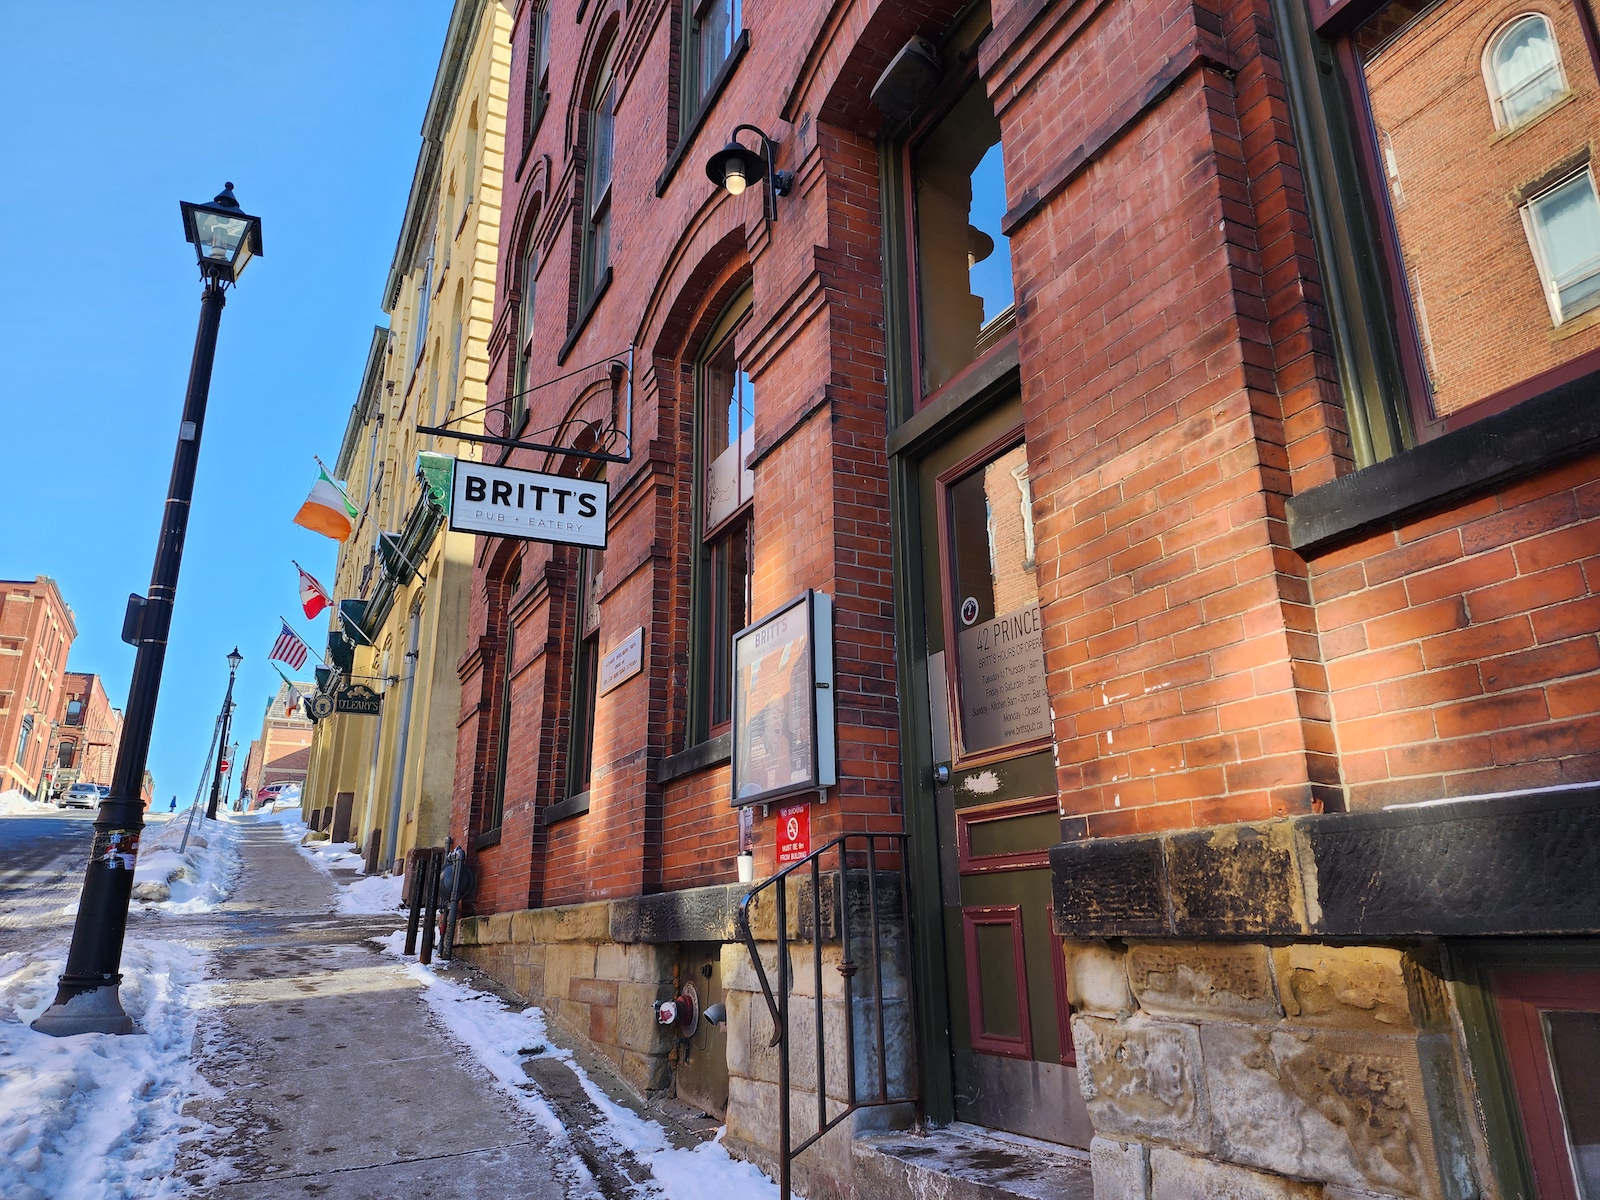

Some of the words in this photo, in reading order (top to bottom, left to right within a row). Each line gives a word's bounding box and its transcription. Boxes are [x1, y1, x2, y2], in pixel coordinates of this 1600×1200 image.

[465, 475, 597, 518] BRITT'S
[475, 510, 505, 522] PUB
[528, 517, 583, 533] EATERY
[976, 627, 990, 652] 42
[997, 646, 1016, 662] HOURS
[1016, 643, 1023, 655] OF
[982, 672, 1000, 685] Tuesday
[1000, 670, 1005, 678] to
[1005, 662, 1026, 677] Thursday
[985, 686, 999, 698] Friday
[999, 684, 1004, 692] to
[1004, 678, 1025, 692] Saturday
[971, 705, 988, 717] Sunday
[990, 699, 1007, 712] Kitchen
[1032, 689, 1041, 700] Bar
[1003, 711, 1020, 723] Monday
[1025, 704, 1041, 717] Closed
[1004, 720, 1043, 738] www.brittspub.ca
[788, 805, 804, 816] SMOKING
[779, 853, 791, 862] FROM
[791, 850, 807, 861] BUILDING
[781, 843, 792, 852] MUST
[792, 842, 798, 851] BE
